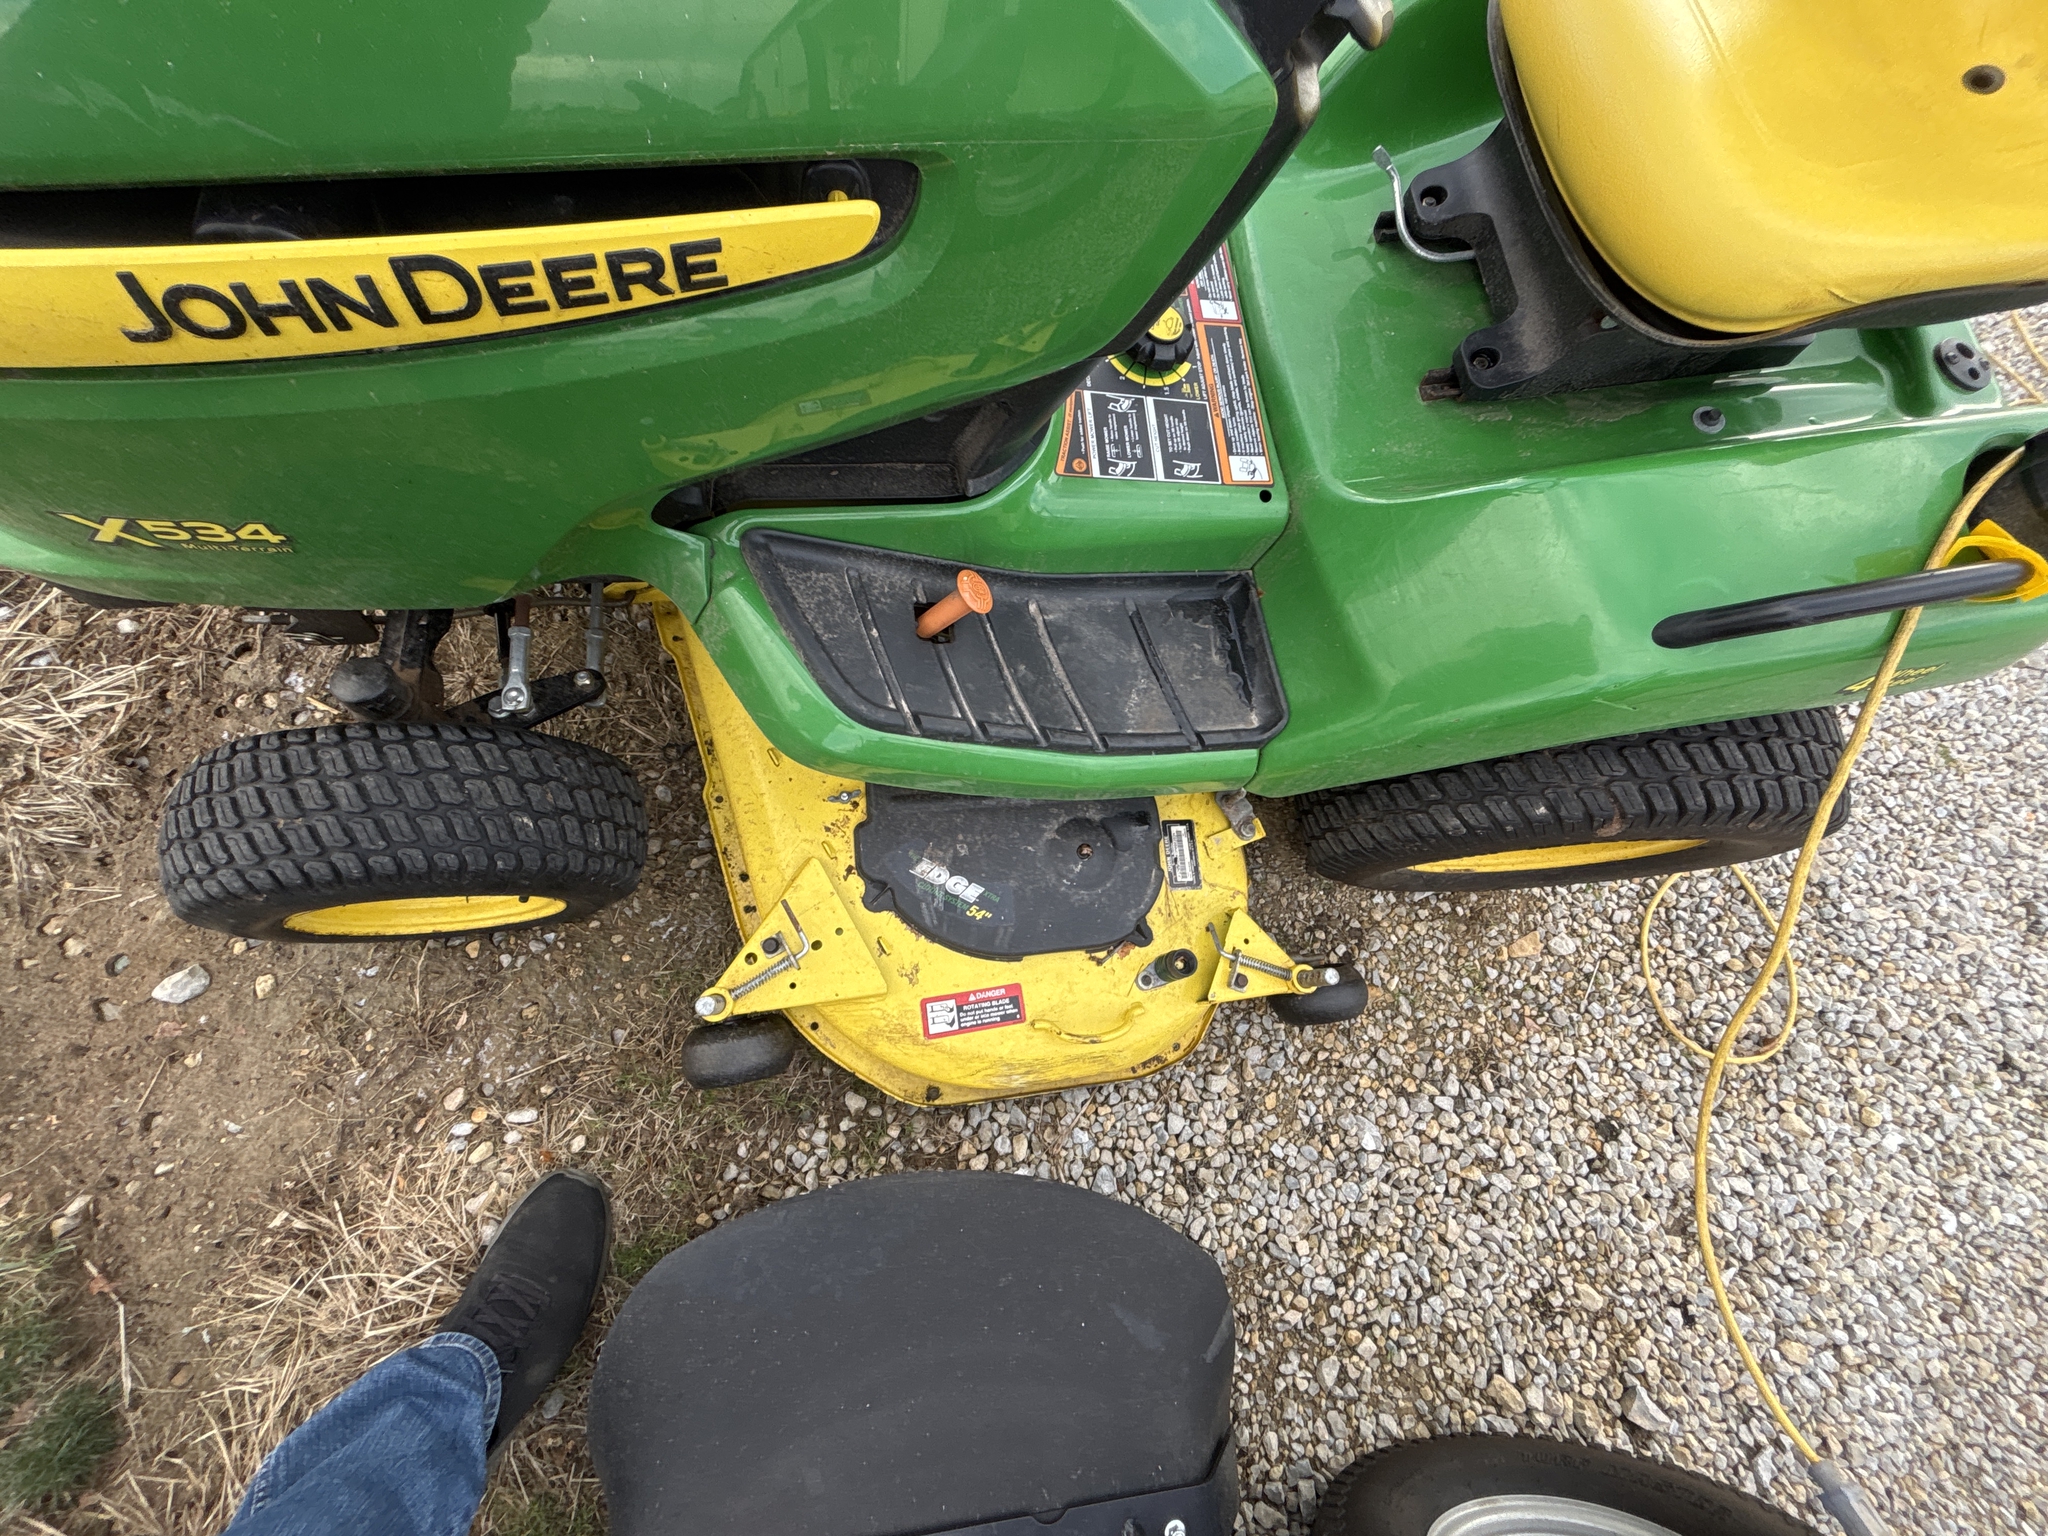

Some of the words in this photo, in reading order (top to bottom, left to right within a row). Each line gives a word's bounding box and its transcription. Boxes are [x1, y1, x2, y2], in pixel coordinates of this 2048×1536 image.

[118, 270, 397, 344] JOHN
[388, 238, 729, 326] DEERE
[1193, 382, 1201, 400] LOWER
[1209, 383, 1218, 413] WARNING
[57, 513, 286, 548] X534
[909, 857, 985, 904] EDGE
[966, 905, 993, 920] 54"
[963, 1001, 991, 1011] ROTATING
[992, 998, 1010, 1006] BLADE
[976, 987, 1006, 1000] DANGER
